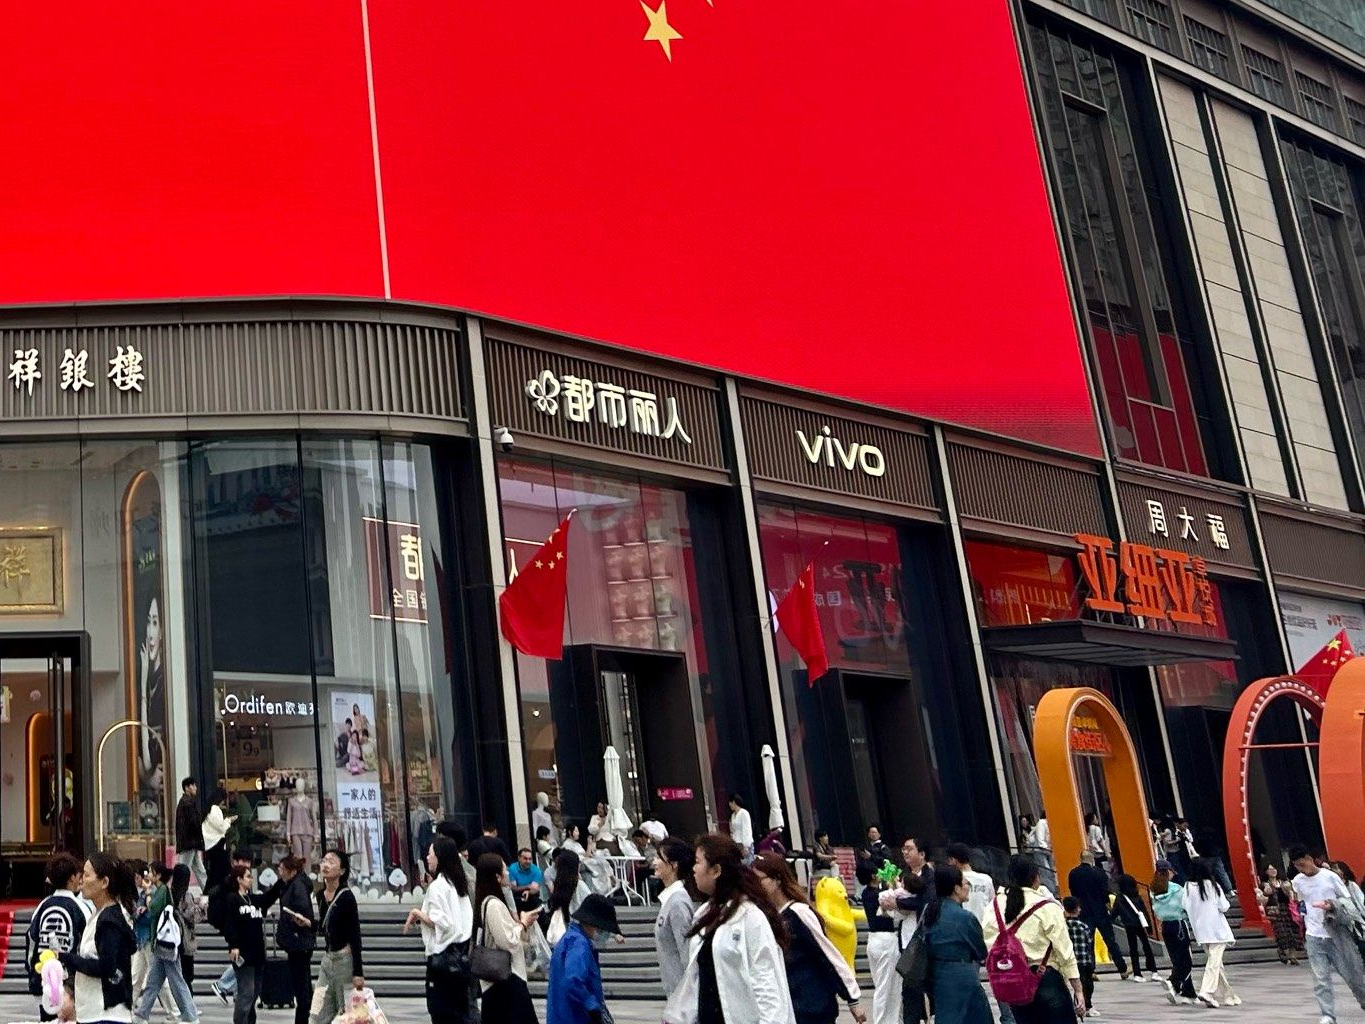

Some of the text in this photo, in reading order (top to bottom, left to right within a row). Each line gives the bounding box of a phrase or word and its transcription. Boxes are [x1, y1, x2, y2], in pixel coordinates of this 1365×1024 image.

[560, 374, 692, 444] 都市丽人
[796, 426, 886, 477] vivo
[1145, 499, 1231, 550] 周大福
[223, 694, 283, 715] Ordifen
[341, 788, 376, 801] 一家人的
